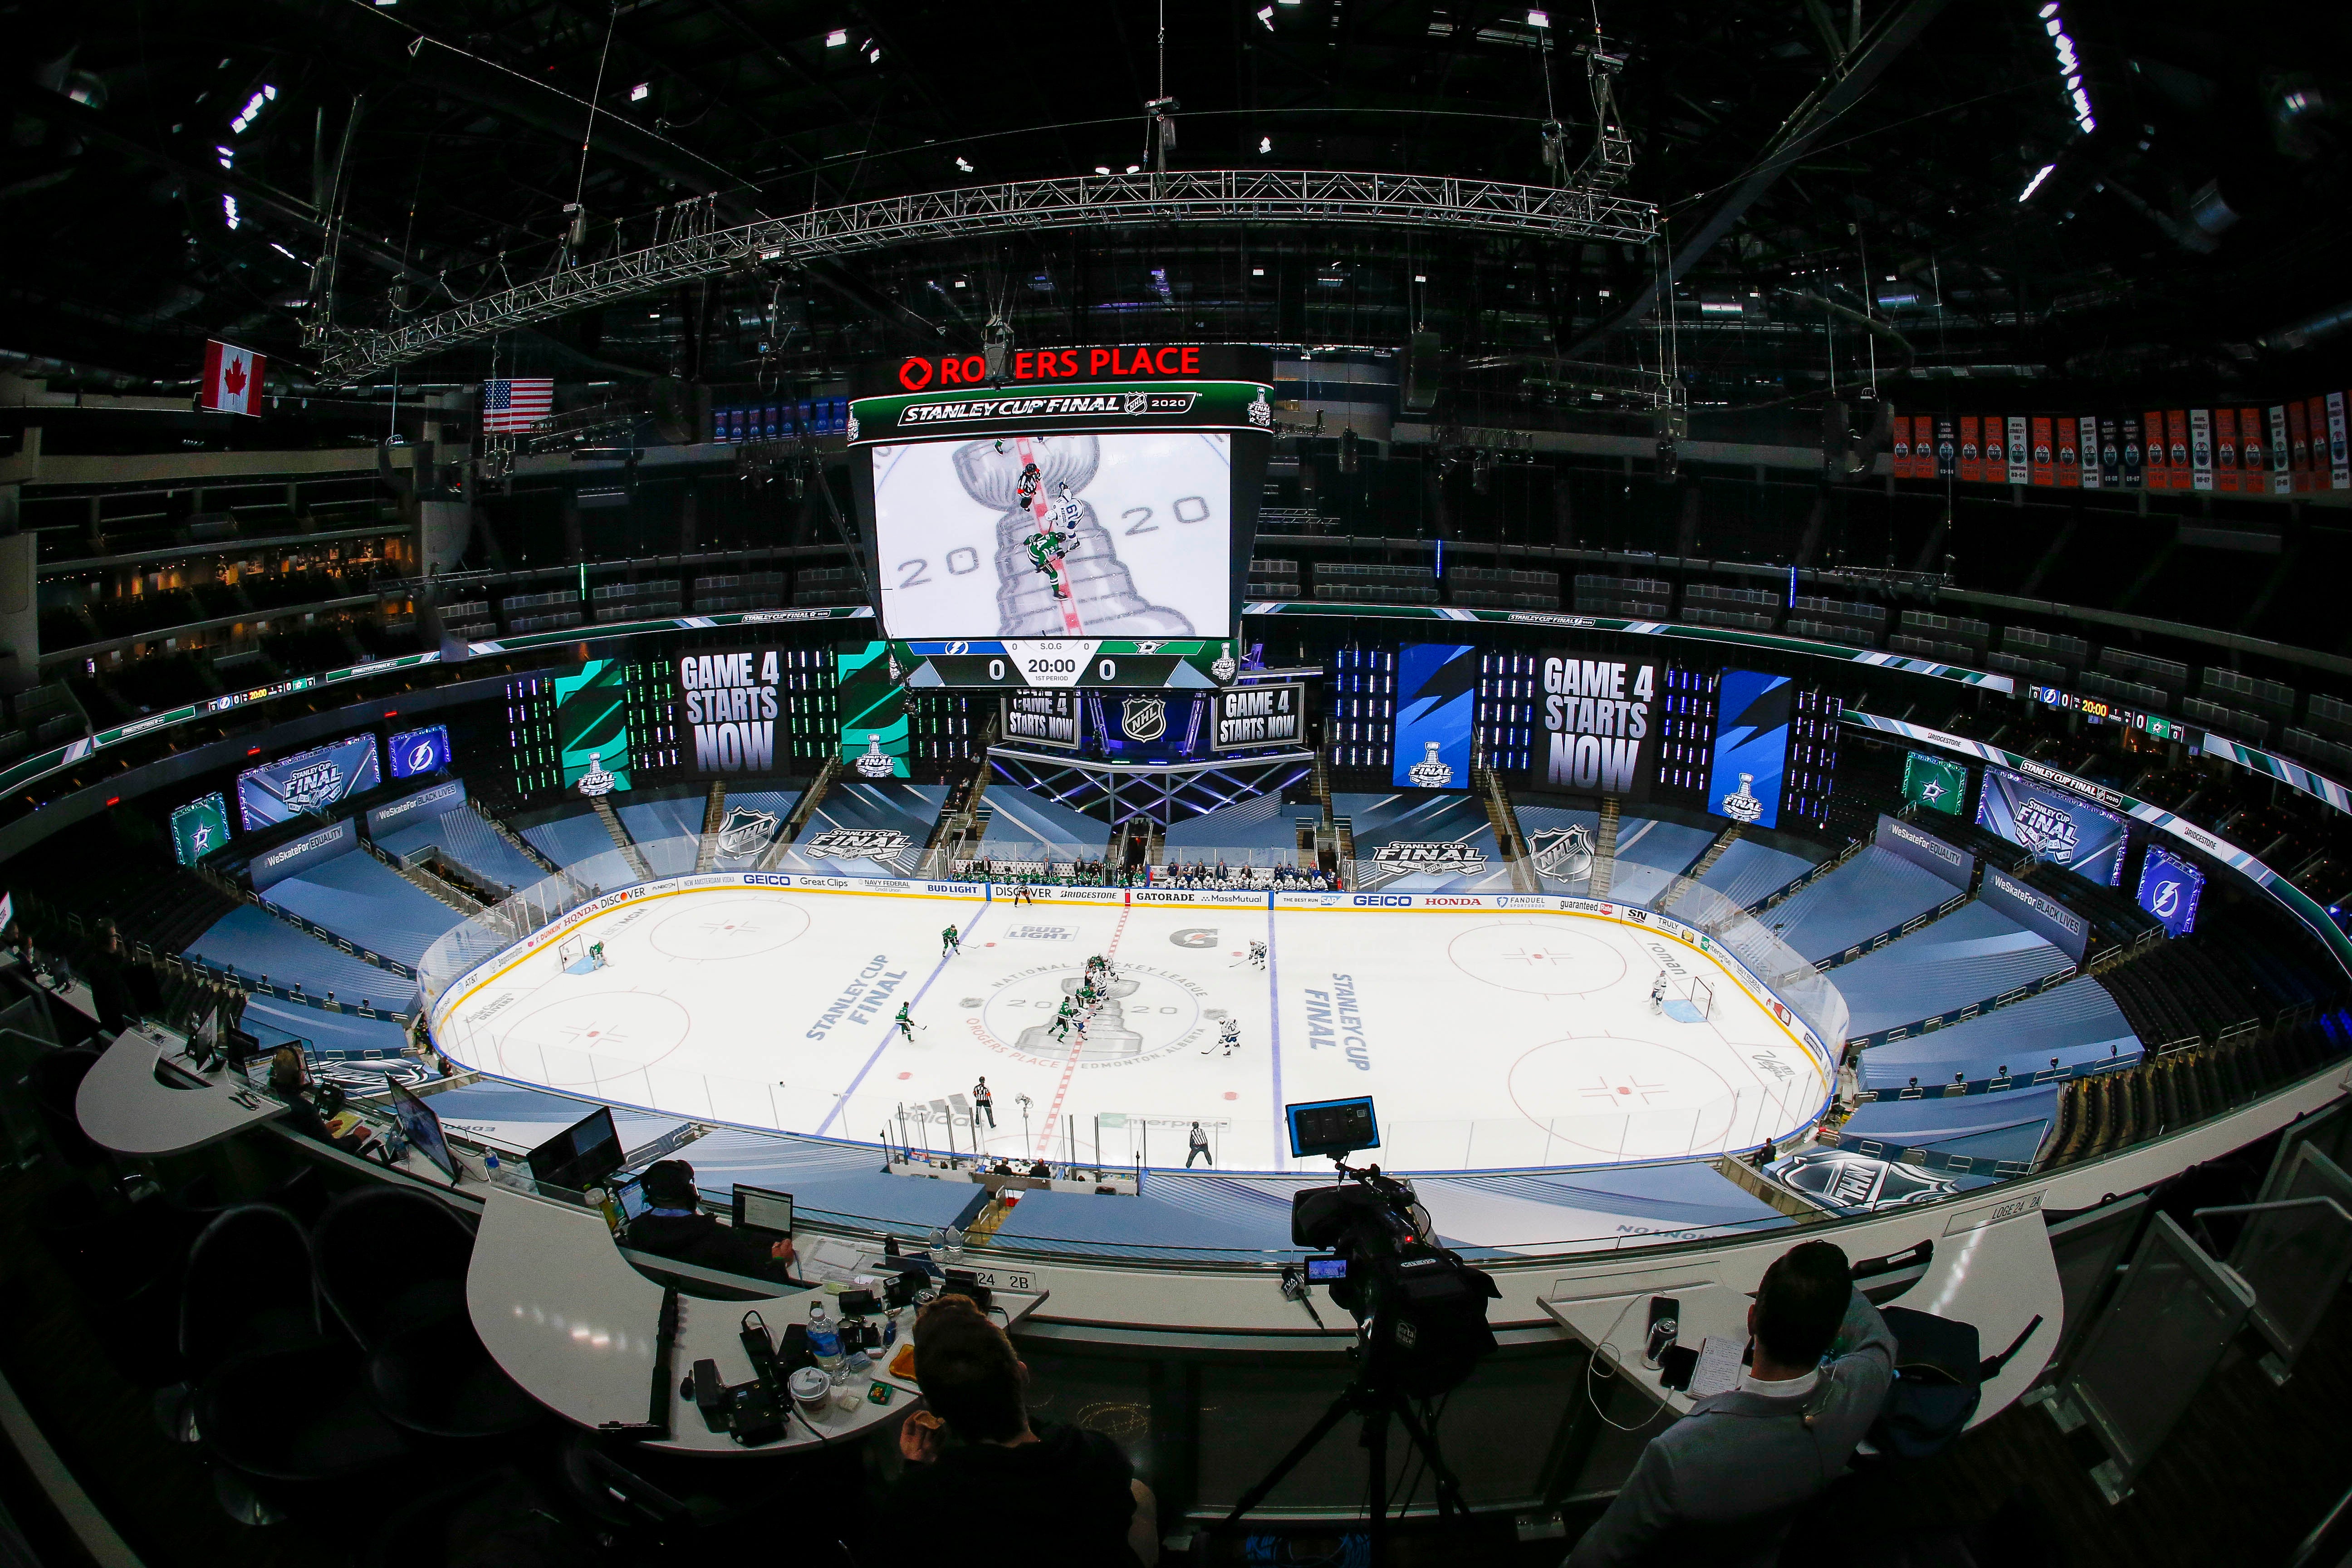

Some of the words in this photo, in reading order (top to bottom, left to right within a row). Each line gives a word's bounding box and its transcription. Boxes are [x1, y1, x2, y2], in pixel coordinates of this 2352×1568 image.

[941, 350, 1078, 384] ROERS
[1091, 348, 1200, 376] PLACE
[905, 402, 1000, 421] STANLEY
[999, 400, 1044, 415] CUP
[1045, 397, 1120, 413] FINAL
[1129, 398, 1145, 411] NHL
[681, 652, 754, 690] GAME
[761, 652, 779, 685] 4
[989, 659, 1005, 680] 0
[1028, 659, 1075, 673] 20:00
[1098, 659, 1116, 681] 0
[1544, 657, 1622, 700] GAME
[1634, 666, 1653, 702] 4
[249, 689, 267, 701] 20:00
[687, 686, 779, 724] STARTS
[1225, 692, 1273, 718] GAME
[1277, 690, 1289, 714] 4
[2062, 694, 2068, 706] 0
[1132, 706, 1158, 731] NHL
[1544, 694, 1647, 738] STARTS
[2081, 699, 2107, 717] 20:00
[2108, 714, 2121, 722] PERIOD
[1009, 711, 1046, 737] STARTS
[1049, 716, 1073, 740] NOW
[1220, 718, 1264, 743] STARTS
[1268, 715, 1295, 739] NOW
[2136, 715, 2144, 729] 0
[1927, 732, 1961, 748] BRIDGESTONE
[2173, 731, 2178, 739] 0
[695, 720, 774, 773] NOW
[292, 767, 318, 780] STANLEY
[318, 763, 331, 771] CUP
[1411, 767, 1451, 775] FINAL
[1549, 734, 1639, 794] NOW
[285, 768, 341, 799] FINAL
[579, 774, 615, 786] FINAL
[2023, 762, 2054, 780] STANLEY
[2054, 773, 2071, 785] CUP
[2070, 778, 2096, 796] FINAL
[2106, 794, 2119, 803] 2020
[417, 791, 438, 806] BLACK
[437, 785, 456, 799] LIVES
[1724, 796, 1761, 812] FINAL
[2029, 801, 2056, 816] STANLEY
[2056, 812, 2070, 823] CUP
[727, 822, 769, 846] NHL
[2016, 806, 2078, 845] FINAL
[310, 827, 343, 849] EQUALITY
[815, 835, 906, 848] FINAL
[2184, 826, 2216, 850] BRIDGESTONE
[1377, 849, 1483, 862] FINAL
[1539, 838, 1579, 867] NHL
[1930, 842, 1960, 865] EQUALITY
[694, 877, 721, 885] AMSTERDAM
[744, 874, 790, 886] GEICO
[800, 877, 826, 887] Great
[827, 878, 848, 888] Clips
[949, 885, 978, 894] LIGHT
[601, 887, 646, 908] DISCOVER
[995, 886, 1052, 898] DISCVER
[1060, 890, 1117, 899] BRIDGESTONE
[1137, 892, 1195, 902] GATORADE
[1211, 894, 1262, 903] MassMutual
[1321, 896, 1337, 905] SAP
[1353, 895, 1412, 906] GEICO
[564, 904, 599, 927] HONDA
[1560, 900, 1598, 911] guaranteed
[1600, 903, 1612, 912] Rate
[1627, 909, 1647, 921] SN
[2036, 898, 2059, 923] BLACK
[2059, 910, 2079, 934] LIVES
[540, 922, 562, 941] DUNKIN'
[601, 908, 649, 936] BETMGM
[1658, 917, 1679, 930] TRULY
[1009, 933, 1073, 941] LIGHT
[1646, 942, 1687, 975] roman
[1702, 939, 1731, 966] enterprise
[465, 973, 478, 988] AT&T
[991, 962, 1071, 988] NATIONAL
[1081, 961, 1157, 972] HCKEY
[1160, 970, 1209, 998] LEAGUE
[479, 997, 514, 1020] DELIVERS
[806, 977, 868, 1041] STANLEY
[861, 955, 890, 980] CUP
[847, 970, 908, 1025] FINAL
[1332, 973, 1364, 1036] STANLEY
[1304, 988, 1337, 1050] FINAL
[970, 1025, 1009, 1054] ROGERS
[1009, 1052, 1060, 1068] PLACE
[1167, 1027, 1206, 1054] ALBERTA
[1343, 1036, 1371, 1072] CUP
[1836, 1162, 1877, 1201] NHL
[1992, 1205, 2015, 1220] LOGE
[2013, 1201, 2025, 1214] 24
[2029, 1195, 2041, 1208] 2A
[977, 1272, 995, 1285] 24
[1009, 1275, 1029, 1289] 2B
[1284, 1277, 1296, 1290] TVA
